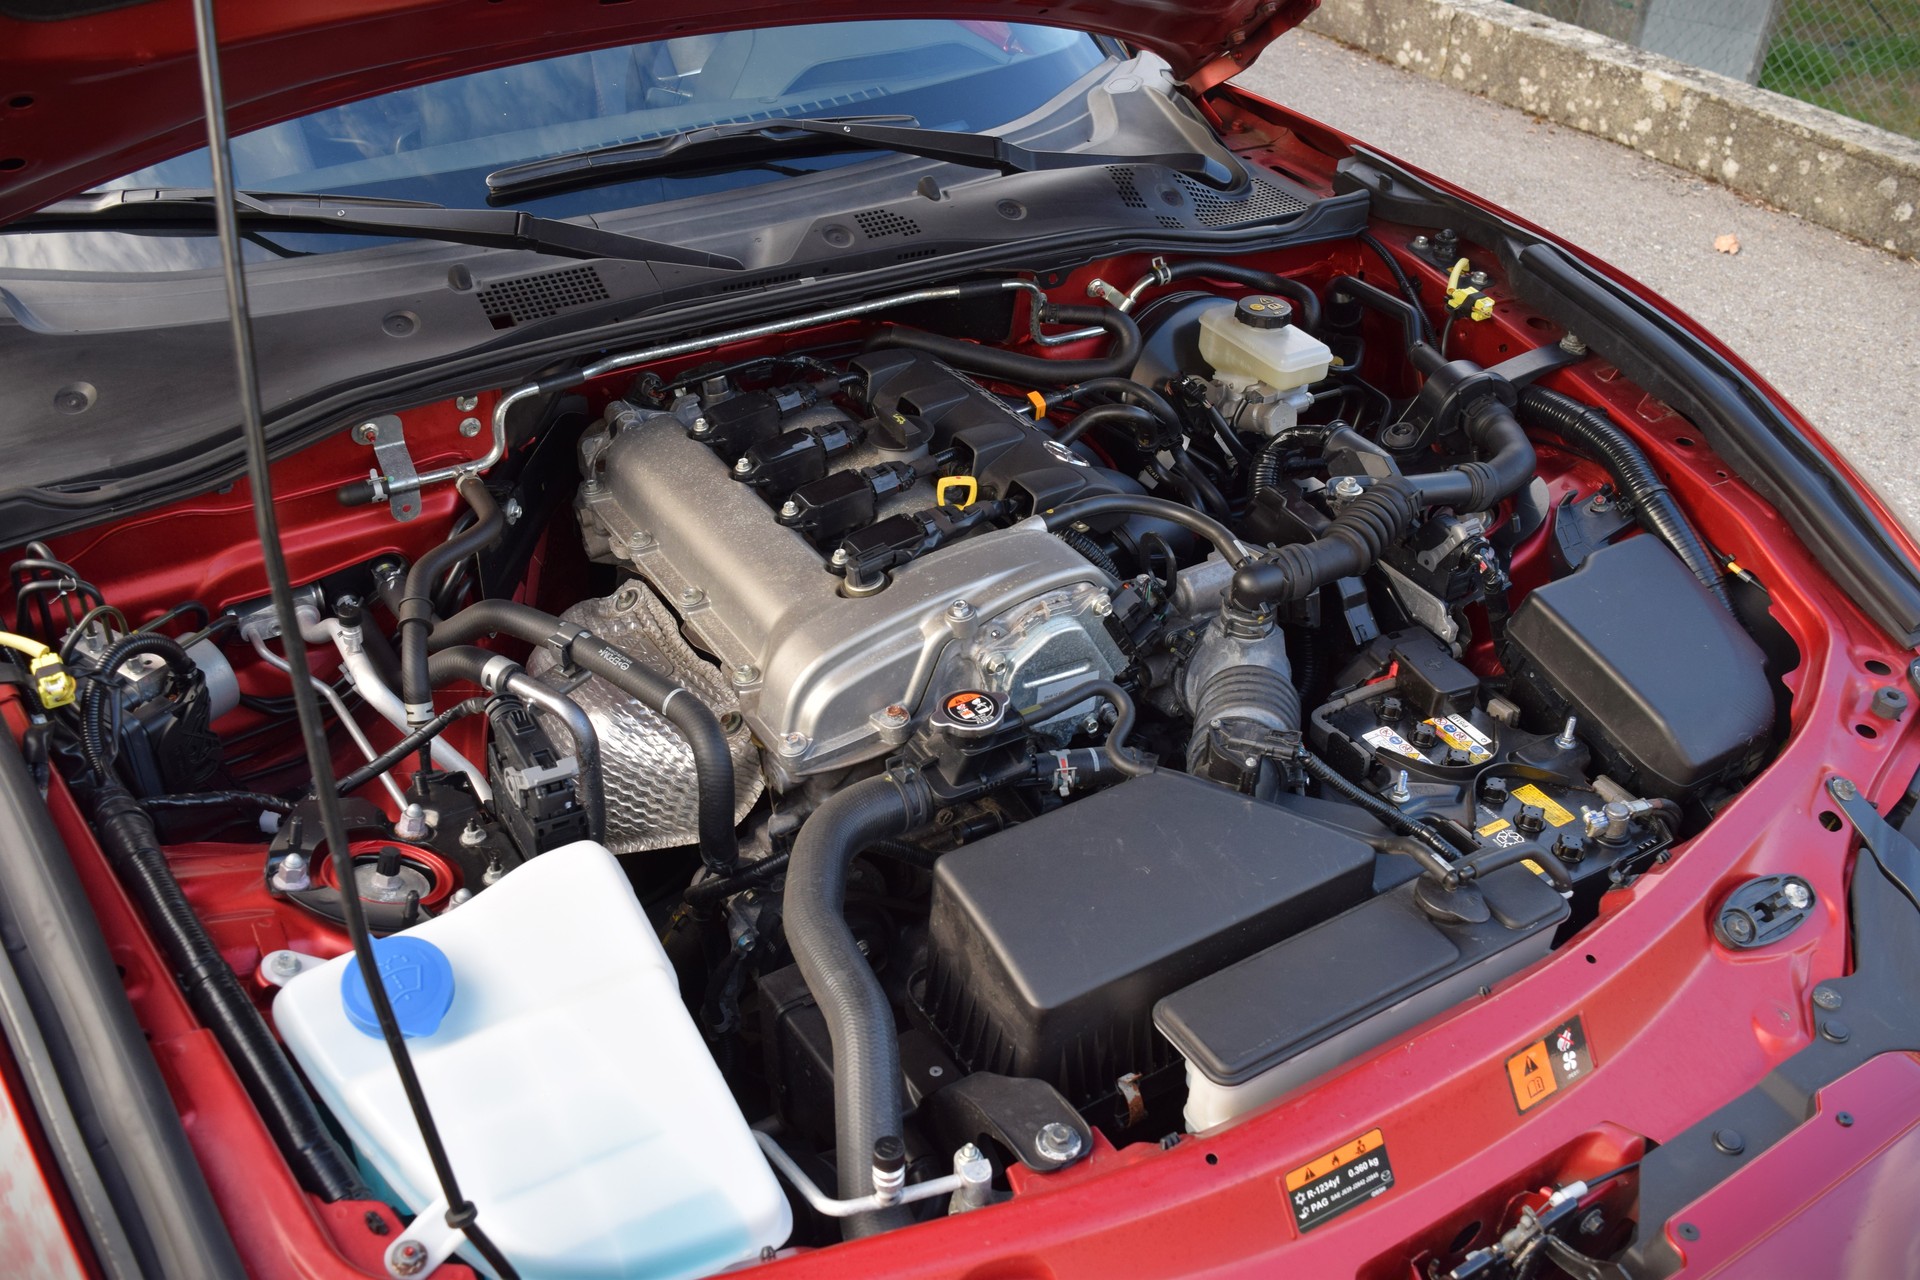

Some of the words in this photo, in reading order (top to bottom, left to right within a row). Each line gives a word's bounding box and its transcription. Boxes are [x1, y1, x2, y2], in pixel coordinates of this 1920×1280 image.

[1348, 1162, 1368, 1178] 0.360
[1368, 1157, 1379, 1168] kg
[1310, 1197, 1329, 1213] PAG
